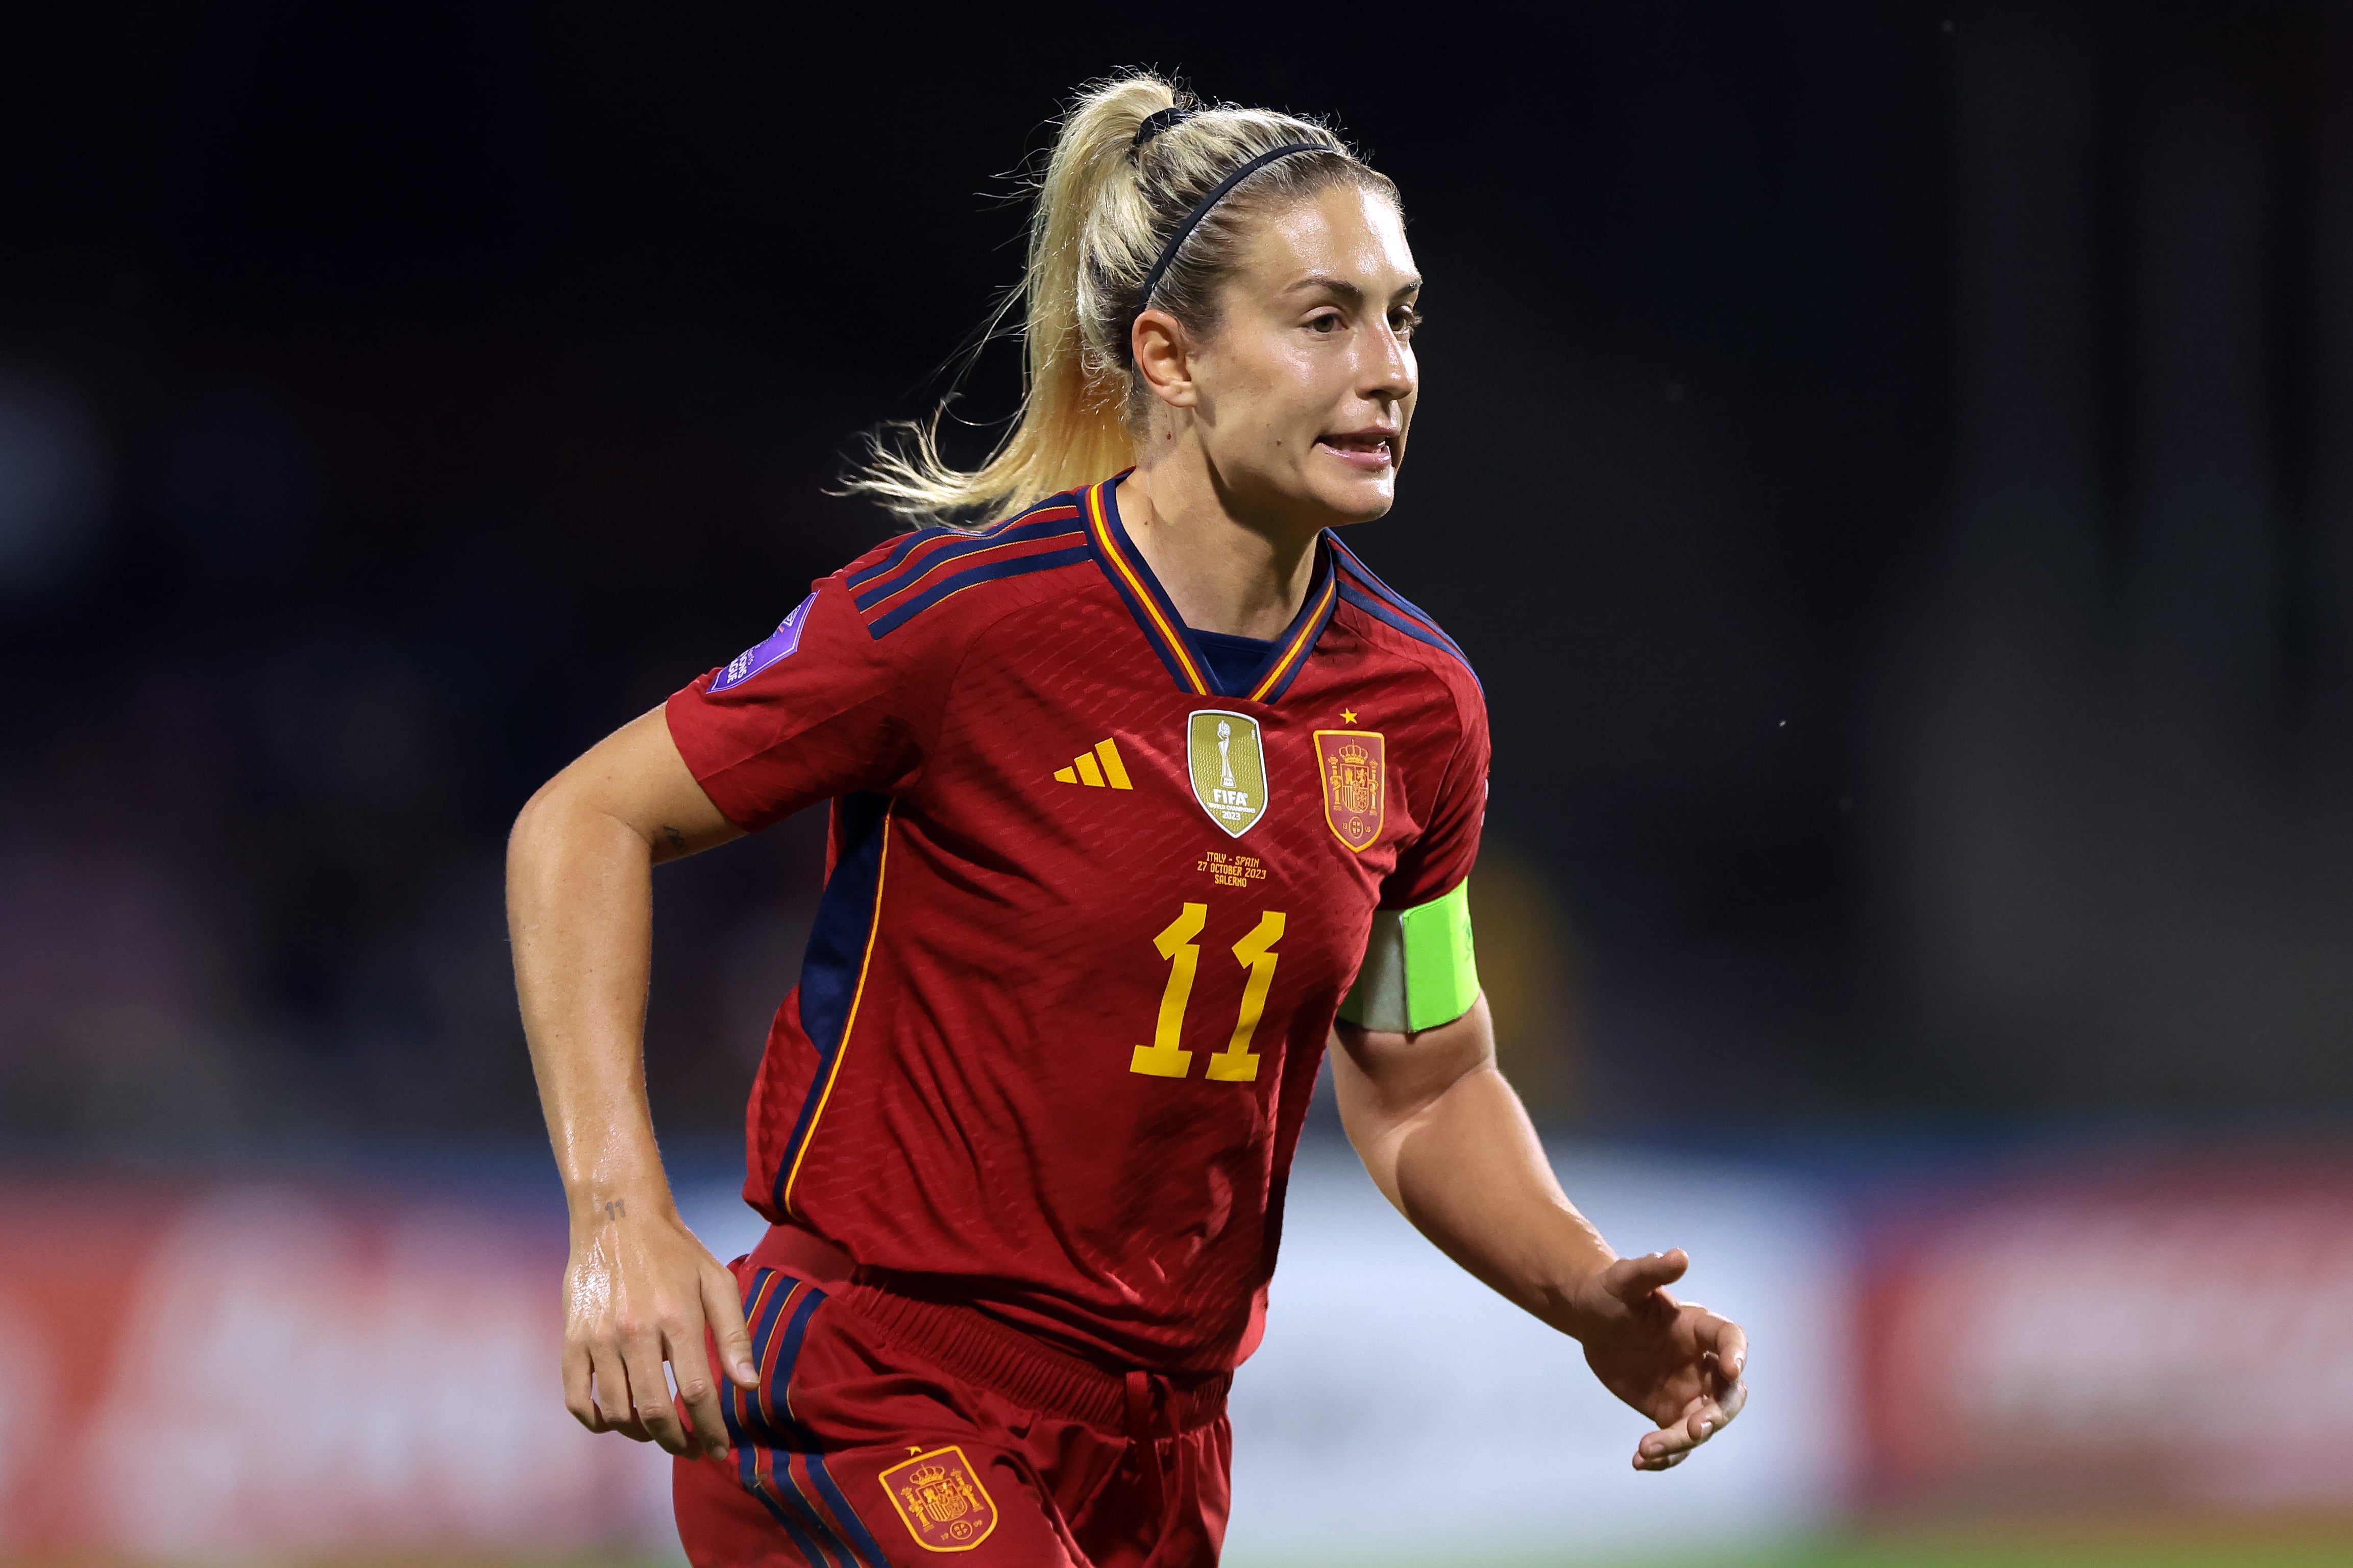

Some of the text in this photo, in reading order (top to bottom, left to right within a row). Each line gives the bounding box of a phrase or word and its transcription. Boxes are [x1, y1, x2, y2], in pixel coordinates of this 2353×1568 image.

[1222, 810, 1241, 821] 2023
[1226, 805, 1256, 813] CHAMPIONS
[1206, 851, 1227, 863] ITALY
[1235, 856, 1260, 868] SPAIN
[1197, 861, 1267, 880] 27 OCTOBER 2023
[1214, 874, 1247, 888] SALERNO
[1130, 902, 1286, 1082] 11
[604, 1198, 626, 1221] 11
